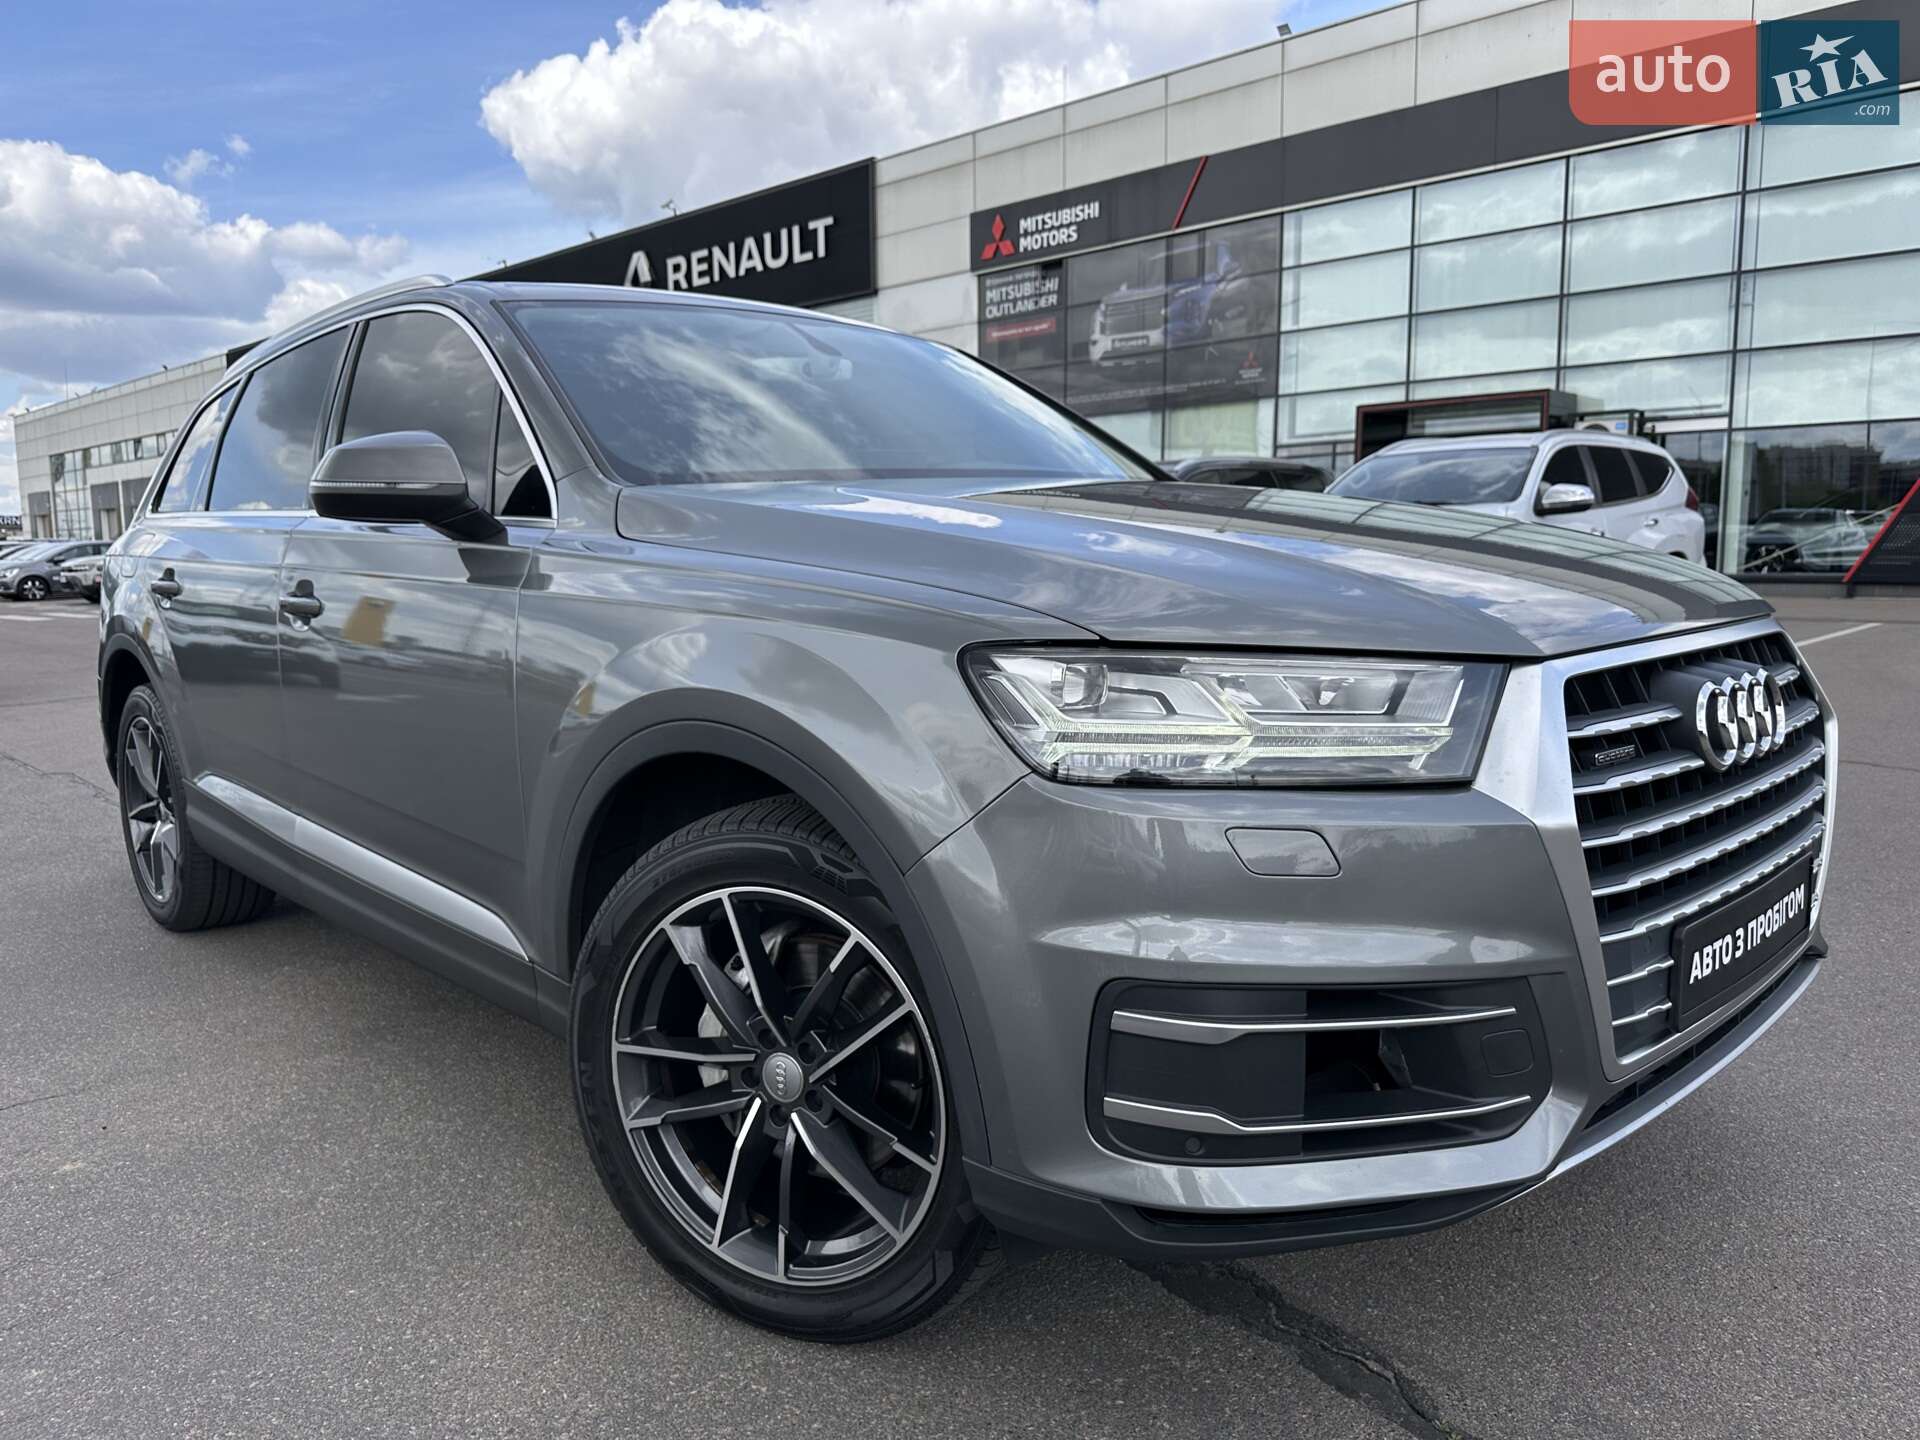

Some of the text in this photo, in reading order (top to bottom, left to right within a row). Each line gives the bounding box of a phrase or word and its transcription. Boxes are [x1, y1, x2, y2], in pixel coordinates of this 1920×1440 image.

[1019, 201, 1100, 235] MITSUBISHI
[1019, 225, 1079, 253] MOTORS
[666, 216, 835, 291] RENAULT
[1689, 883, 1805, 985] АВТО З ПРОБІГОМ
